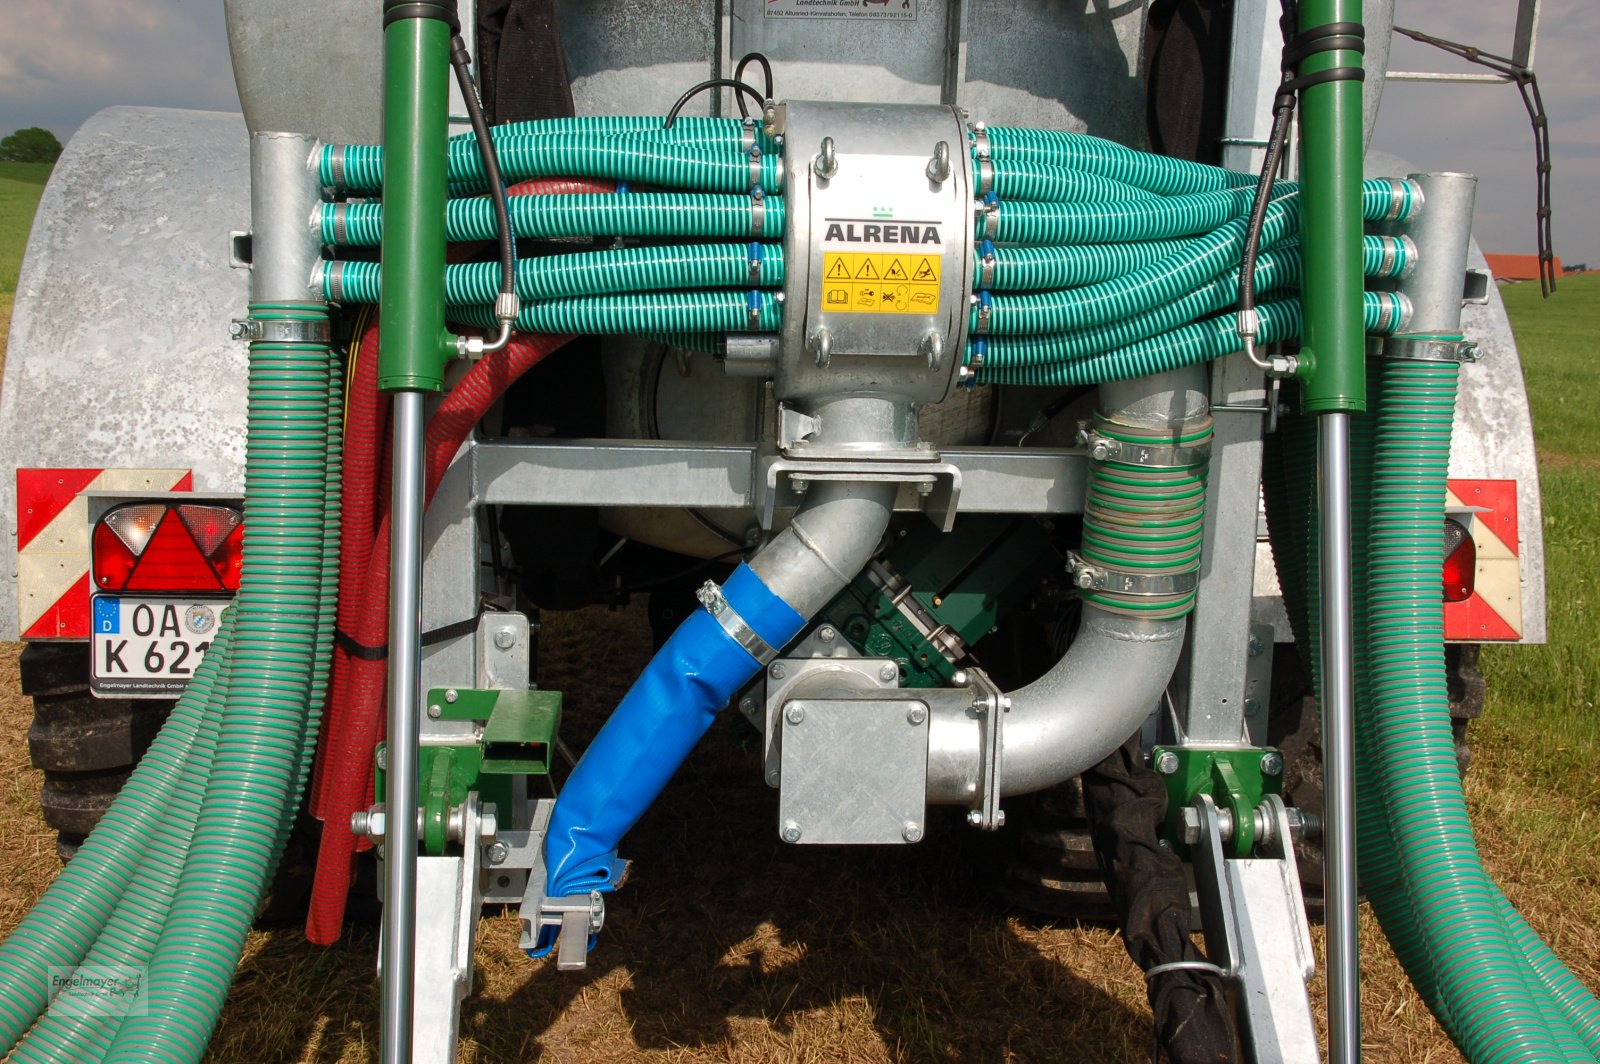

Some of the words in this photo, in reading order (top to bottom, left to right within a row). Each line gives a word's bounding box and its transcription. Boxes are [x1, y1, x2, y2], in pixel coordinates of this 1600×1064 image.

[824, 224, 942, 244] ALRENA
[102, 620, 112, 632] D
[132, 604, 181, 637] OA
[106, 640, 128, 672] K
